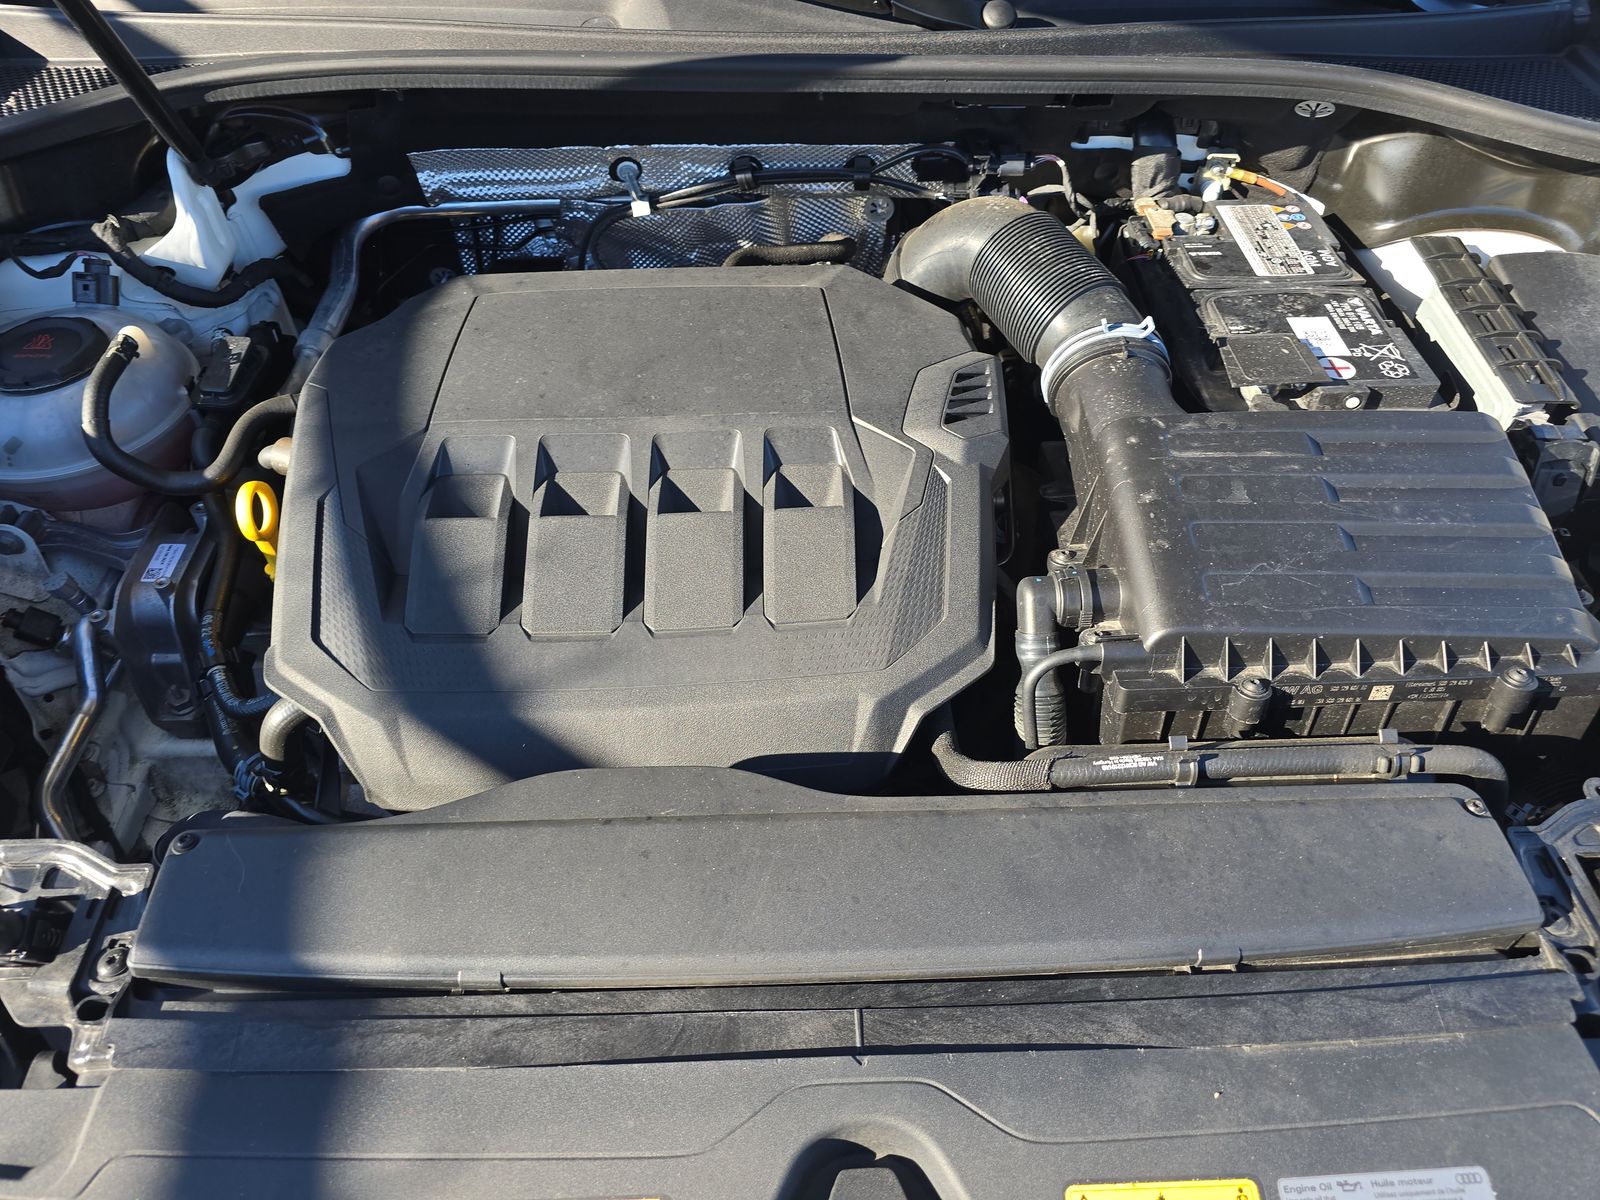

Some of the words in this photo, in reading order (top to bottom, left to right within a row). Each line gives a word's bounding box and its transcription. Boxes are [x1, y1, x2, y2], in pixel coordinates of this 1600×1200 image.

[1316, 249, 1340, 267] AGM
[1355, 306, 1384, 336] VARTA
[1300, 684, 1324, 695] AG
[1282, 1183, 1317, 1195] Engine
[1319, 1182, 1333, 1191] Oil
[1369, 1178, 1396, 1188] Huile
[1397, 1177, 1433, 1186] moteur
